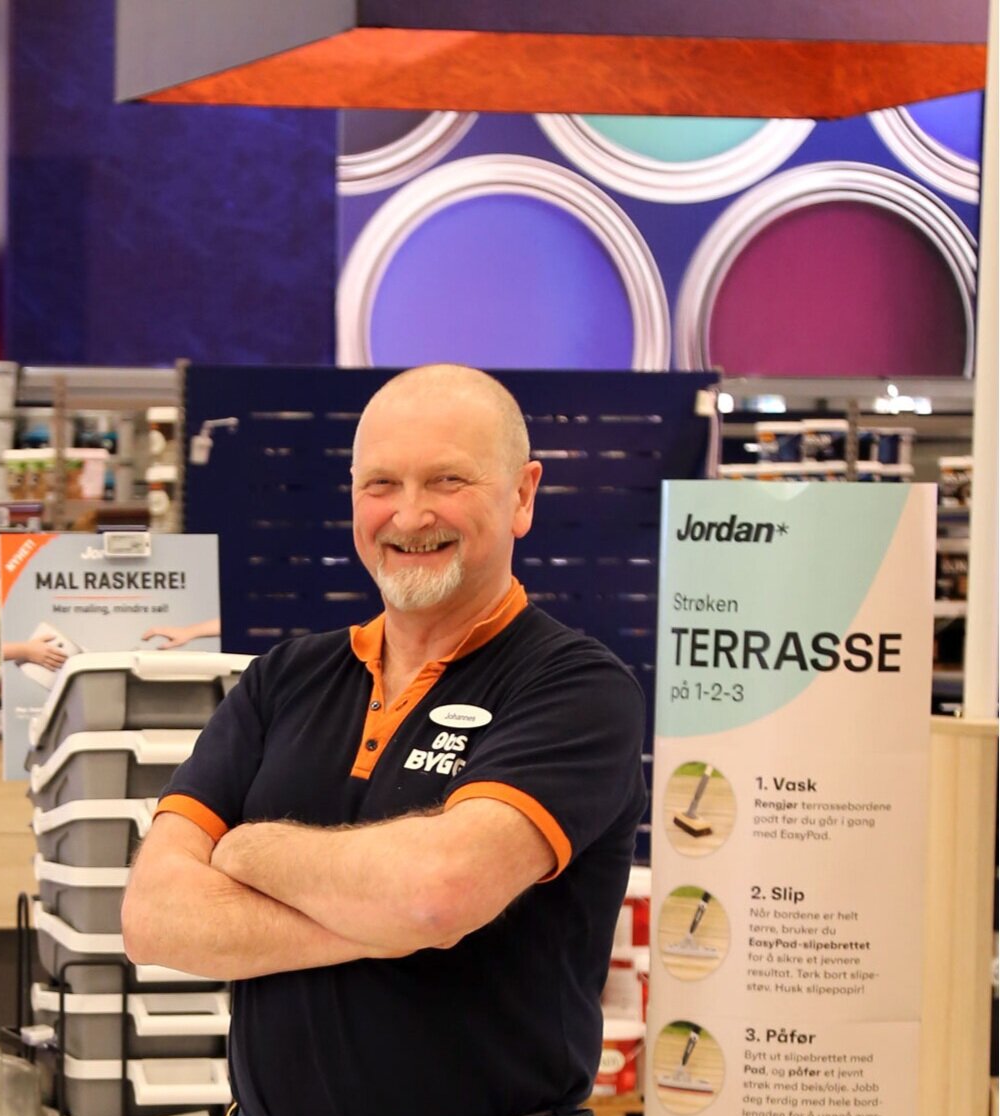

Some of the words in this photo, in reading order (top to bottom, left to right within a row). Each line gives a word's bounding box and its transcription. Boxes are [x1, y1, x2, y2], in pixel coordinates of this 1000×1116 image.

[36, 572, 78, 589] MAL
[84, 572, 186, 589] RASKERE!
[673, 592, 738, 613] Strøken
[671, 627, 902, 673] TERRASSE
[671, 681, 690, 701] på
[696, 683, 744, 702] 1-2-3
[756, 777, 767, 790] 1.
[773, 777, 817, 792] Vask
[755, 799, 798, 811] Rengjør
[801, 801, 892, 812] terrassebordene
[754, 814, 778, 825] godt
[782, 815, 797, 825] før
[801, 816, 816, 825] du
[818, 814, 838, 828] går
[847, 819, 876, 828] gang
[753, 829, 777, 839] med
[751, 886, 766, 900] 2.
[771, 886, 805, 904] Slip
[750, 907, 770, 918] Når
[773, 909, 820, 920] bordene
[823, 913, 834, 921] er
[837, 911, 858, 921] helt
[782, 924, 818, 935] bruker
[821, 925, 836, 936] du
[748, 937, 870, 951] EasyPad-slipebrettet
[748, 952, 763, 962] for
[777, 954, 803, 964] sikre
[806, 956, 817, 965] et
[823, 969, 847, 980] bort
[775, 983, 803, 993] Husk
[745, 1028, 760, 1042] 3.
[766, 1028, 816, 1044] Påfør
[770, 1052, 781, 1061] ut
[850, 1053, 874, 1063] med
[771, 1068, 785, 1077] og
[788, 1066, 821, 1078] påfør
[824, 1069, 834, 1078] et
[774, 1081, 798, 1091] med
[742, 1095, 763, 1105] deg
[766, 1096, 798, 1107] ferdig
[801, 1097, 825, 1106] med
[829, 1097, 850, 1107] hele
